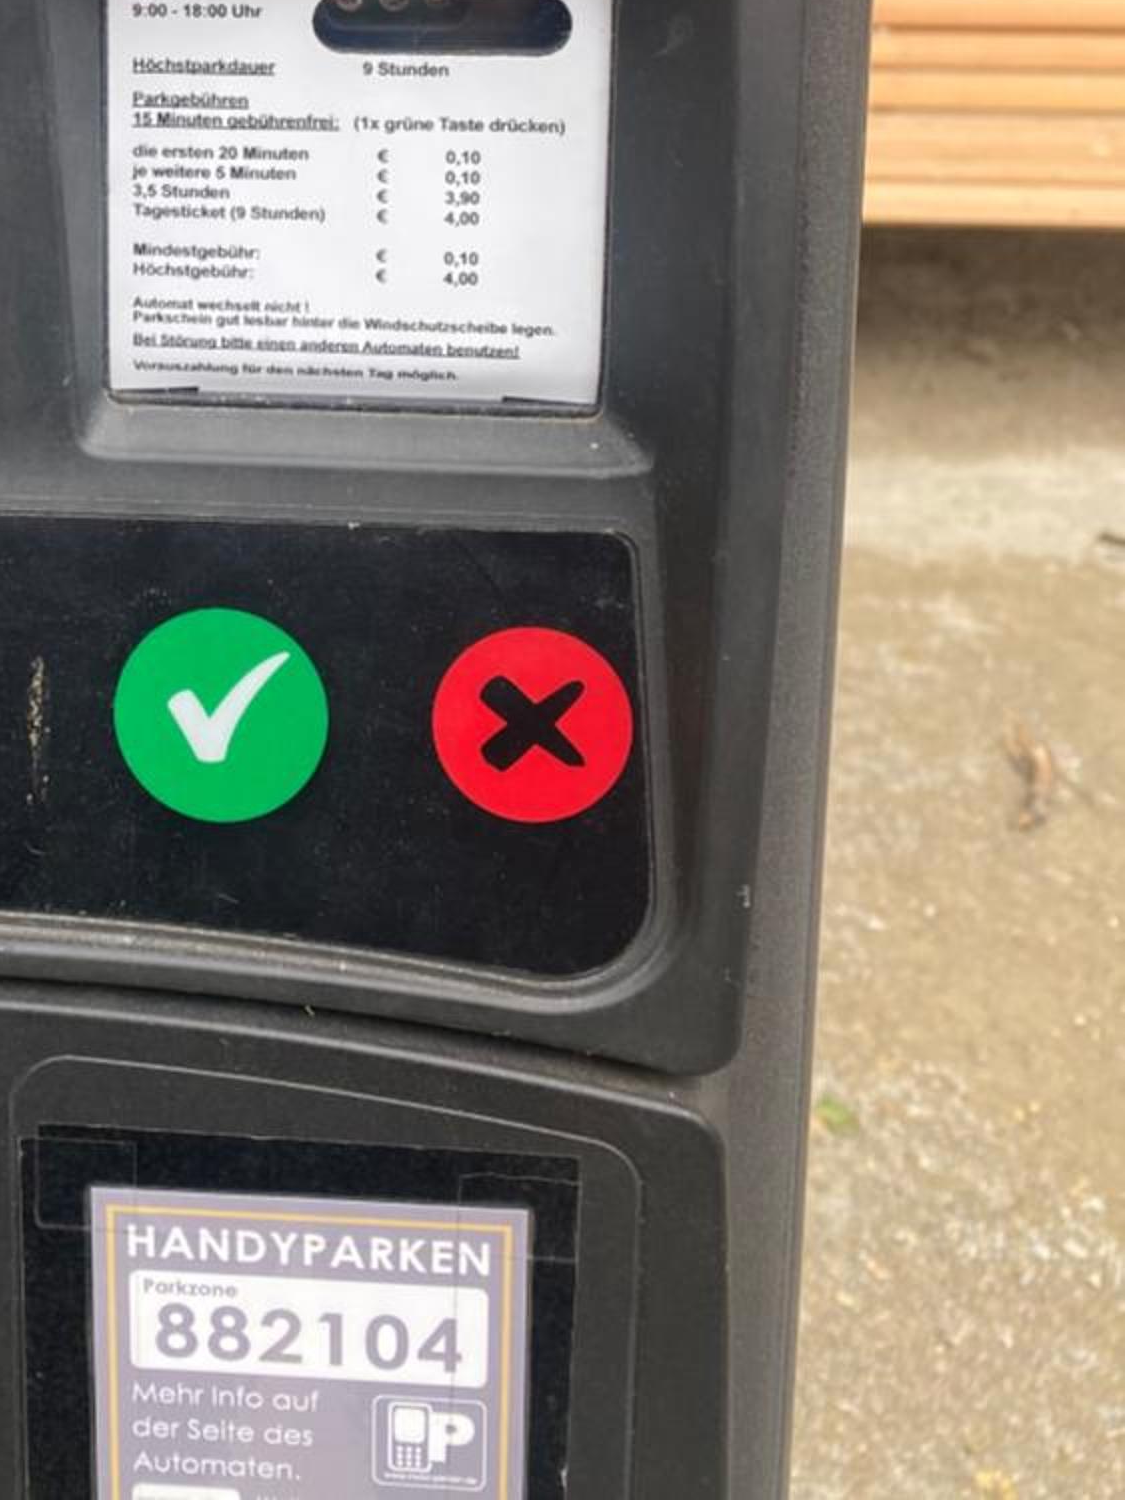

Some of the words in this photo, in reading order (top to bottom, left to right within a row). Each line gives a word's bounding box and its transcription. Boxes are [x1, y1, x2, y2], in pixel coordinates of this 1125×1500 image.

[132, 4, 167, 17] 9:00
[183, 4, 227, 18] 18:00
[231, 4, 262, 18] Uhr
[132, 58, 276, 76] Höchstparkdauer
[362, 63, 372, 76] 9
[377, 63, 449, 77] Stunden
[132, 91, 249, 110] Parkgebühren
[132, 112, 153, 128] 15
[156, 112, 224, 129] Minuten
[227, 113, 340, 132] gebührenfrei:
[353, 116, 379, 132] (1x
[384, 116, 434, 134] grüne
[439, 116, 484, 132] Taste
[489, 117, 566, 136] drücken)
[132, 145, 158, 159] die
[161, 147, 214, 160] ersten
[218, 146, 238, 160] 20
[242, 146, 309, 161] Minuten
[377, 148, 389, 163] €
[445, 149, 481, 166] 0,10
[131, 164, 147, 180] je
[152, 165, 211, 179] weitere
[216, 166, 225, 179] 5
[230, 165, 296, 181] Minuten
[376, 168, 388, 184] €
[445, 170, 481, 187] 0,10
[132, 183, 157, 199] 3,5
[161, 183, 230, 199] Stunden
[376, 188, 388, 204] €
[444, 190, 480, 207] 3,90
[133, 203, 225, 220] Tagesticket
[229, 205, 246, 222] (9
[250, 206, 326, 224] Stunden)
[375, 208, 388, 224] €
[443, 211, 480, 228] 4,00
[132, 243, 260, 260] Mindestgebühr:
[375, 248, 387, 264] €
[443, 251, 479, 268] 0,10
[132, 262, 255, 280] Höchstgebühr:
[375, 268, 386, 284] €
[442, 271, 479, 288] 4,00
[133, 296, 193, 310] Automat
[196, 299, 260, 312] wechselt
[264, 300, 301, 313] nicht
[132, 310, 212, 325] Parkschein
[215, 314, 240, 328] gut
[243, 314, 288, 327] lesbar
[292, 315, 335, 329] hinter
[338, 316, 361, 330] die
[363, 317, 508, 335] Windschutzscheibe
[511, 322, 555, 338] legen.
[132, 332, 157, 348] Bei
[160, 333, 217, 350] Störung
[220, 335, 253, 351] bitte
[256, 338, 296, 352] einen
[299, 338, 359, 354] anderen
[363, 340, 444, 357] Automaten
[446, 343, 521, 360] benutzen!
[133, 358, 239, 375] Vorauszahlung
[242, 361, 262, 374] für
[266, 363, 294, 375] den
[296, 364, 364, 377] nächsten
[368, 367, 393, 380] Tag
[397, 368, 459, 382] möglich.
[126, 1224, 492, 1277] HANDYPARKEN
[143, 1278, 239, 1299] Parkzone
[155, 1302, 463, 1374] 882104
[132, 1383, 204, 1407] Mehr
[211, 1384, 264, 1410] Info
[272, 1387, 321, 1413] auf
[132, 1416, 179, 1440] der
[186, 1418, 256, 1444] Seite
[263, 1422, 314, 1448] des
[133, 1450, 302, 1481] Automaten.
